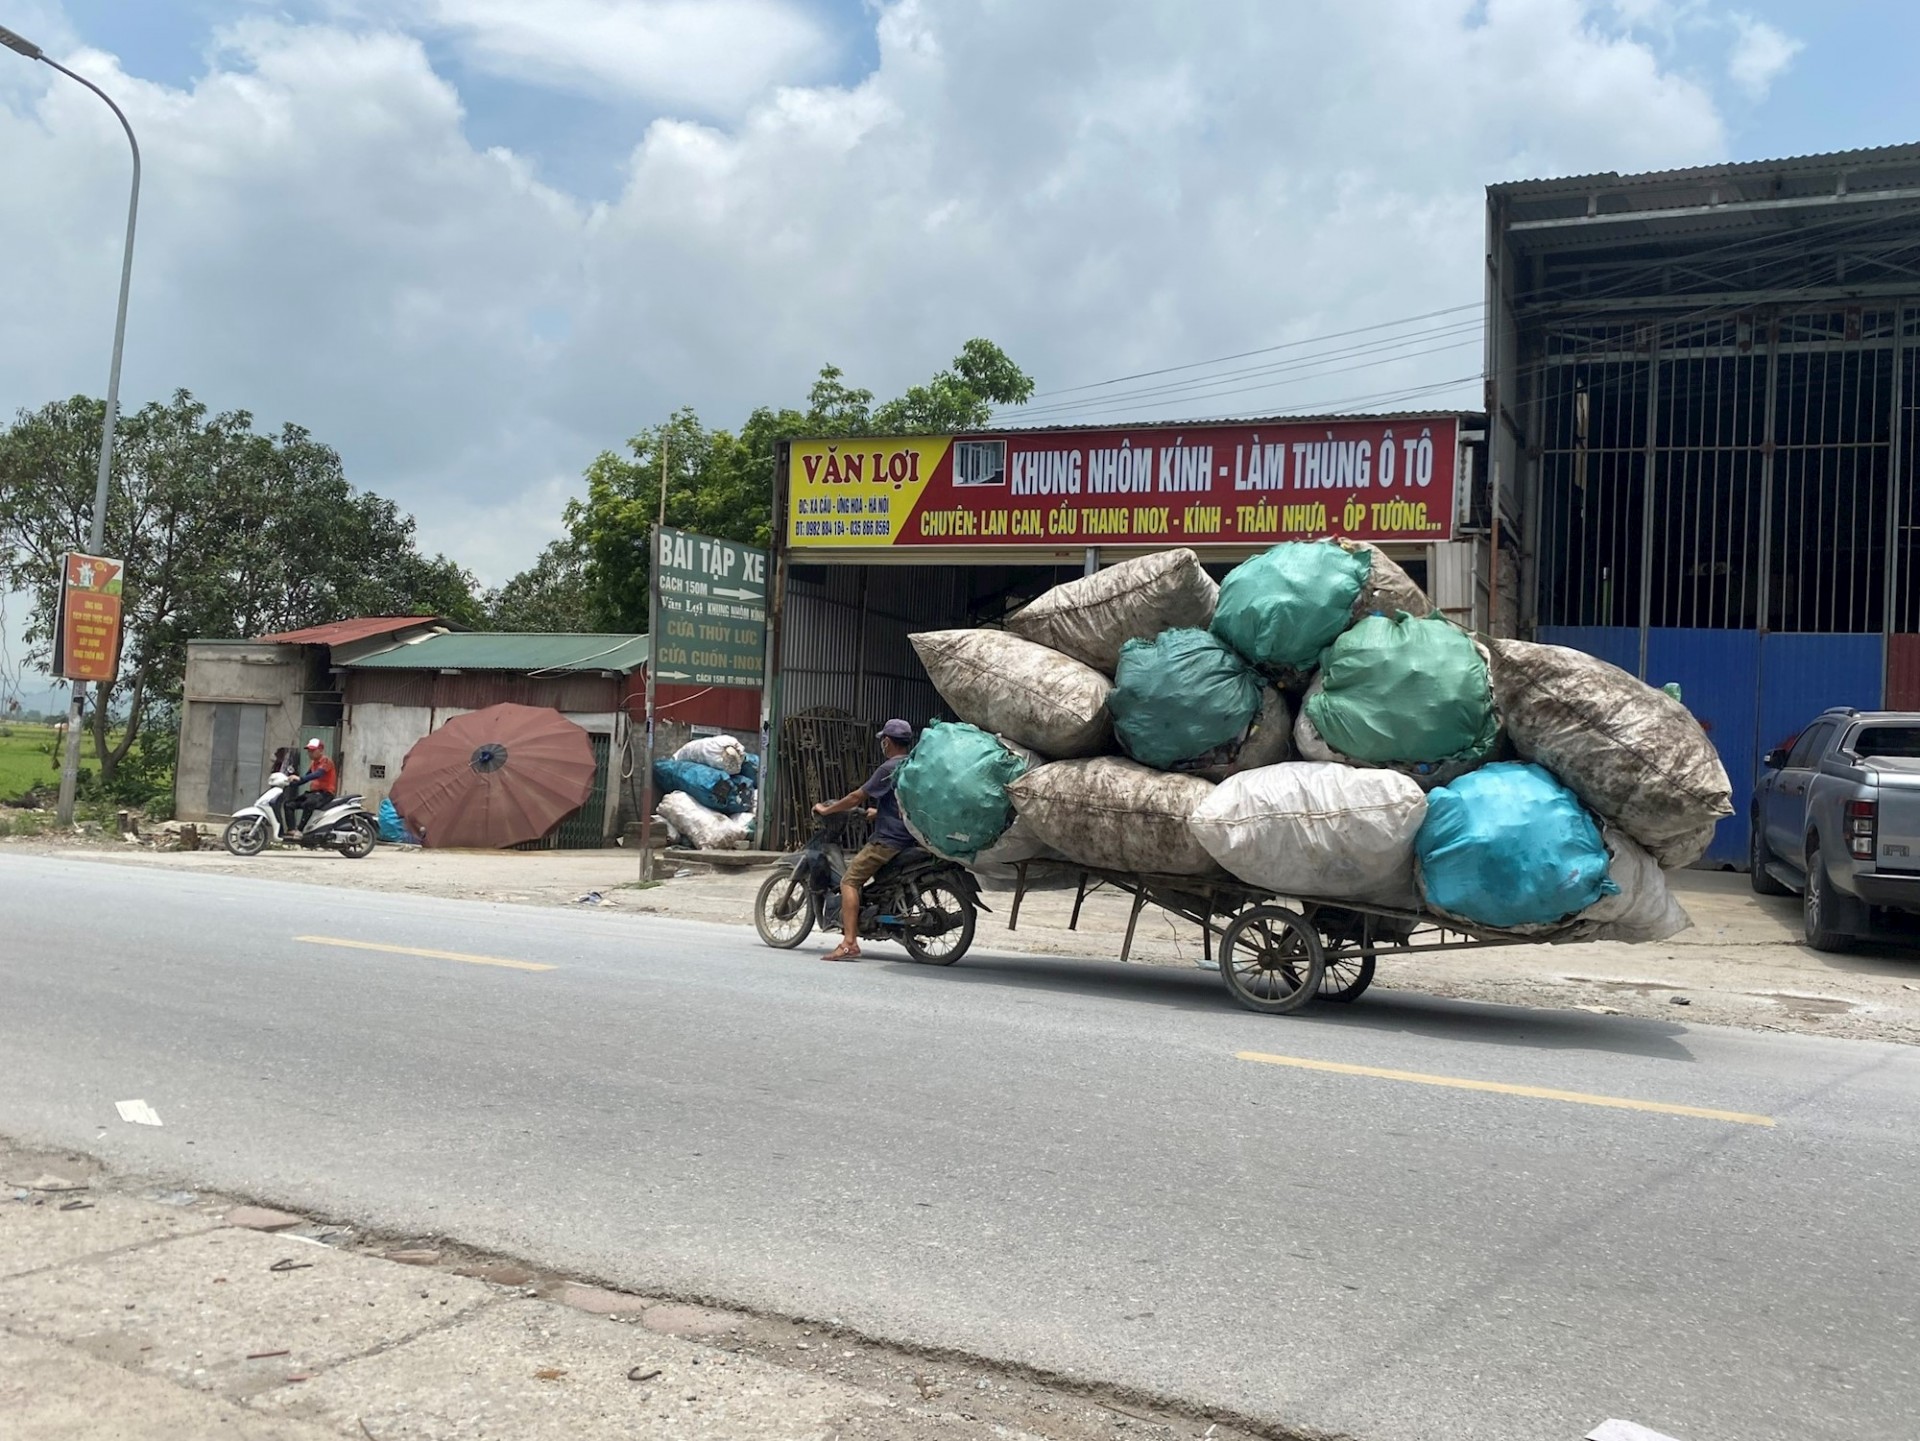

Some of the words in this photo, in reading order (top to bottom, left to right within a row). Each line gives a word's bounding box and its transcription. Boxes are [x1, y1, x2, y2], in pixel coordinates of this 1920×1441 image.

[802, 445, 864, 484] VĂN
[871, 449, 920, 490] LỢI
[1011, 449, 1082, 495] KHUNG
[1087, 438, 1153, 494] NHÔM
[1159, 436, 1213, 492] KÍNH
[1235, 434, 1286, 491] LÀM
[1293, 431, 1371, 489] THÙNG
[1378, 429, 1395, 488] Ô
[1403, 427, 1433, 487] TÔ
[920, 505, 977, 536] CHUYÊN:
[981, 510, 1008, 536] LAN
[1011, 509, 1044, 538] CAN,
[1049, 499, 1077, 535] CẦU
[1081, 508, 1128, 535] THANG
[1133, 507, 1169, 534] INOX
[1183, 501, 1221, 533] KÍNH
[1237, 496, 1278, 533] TRẦN
[1282, 501, 1327, 538] NHỰA
[1343, 493, 1366, 531] ỐP
[660, 531, 693, 570] BÃI
[700, 539, 735, 580] TẬP
[742, 551, 765, 584] XE
[660, 572, 683, 592] CÁCH
[685, 580, 708, 596] 150M
[686, 600, 703, 616] Lợi
[667, 617, 695, 638] CỬA
[699, 621, 731, 642] THỦY
[734, 629, 757, 648] LỰC
[659, 643, 687, 665] CỬA
[696, 673, 712, 683] CÁCH
[713, 674, 725, 684] 15M
